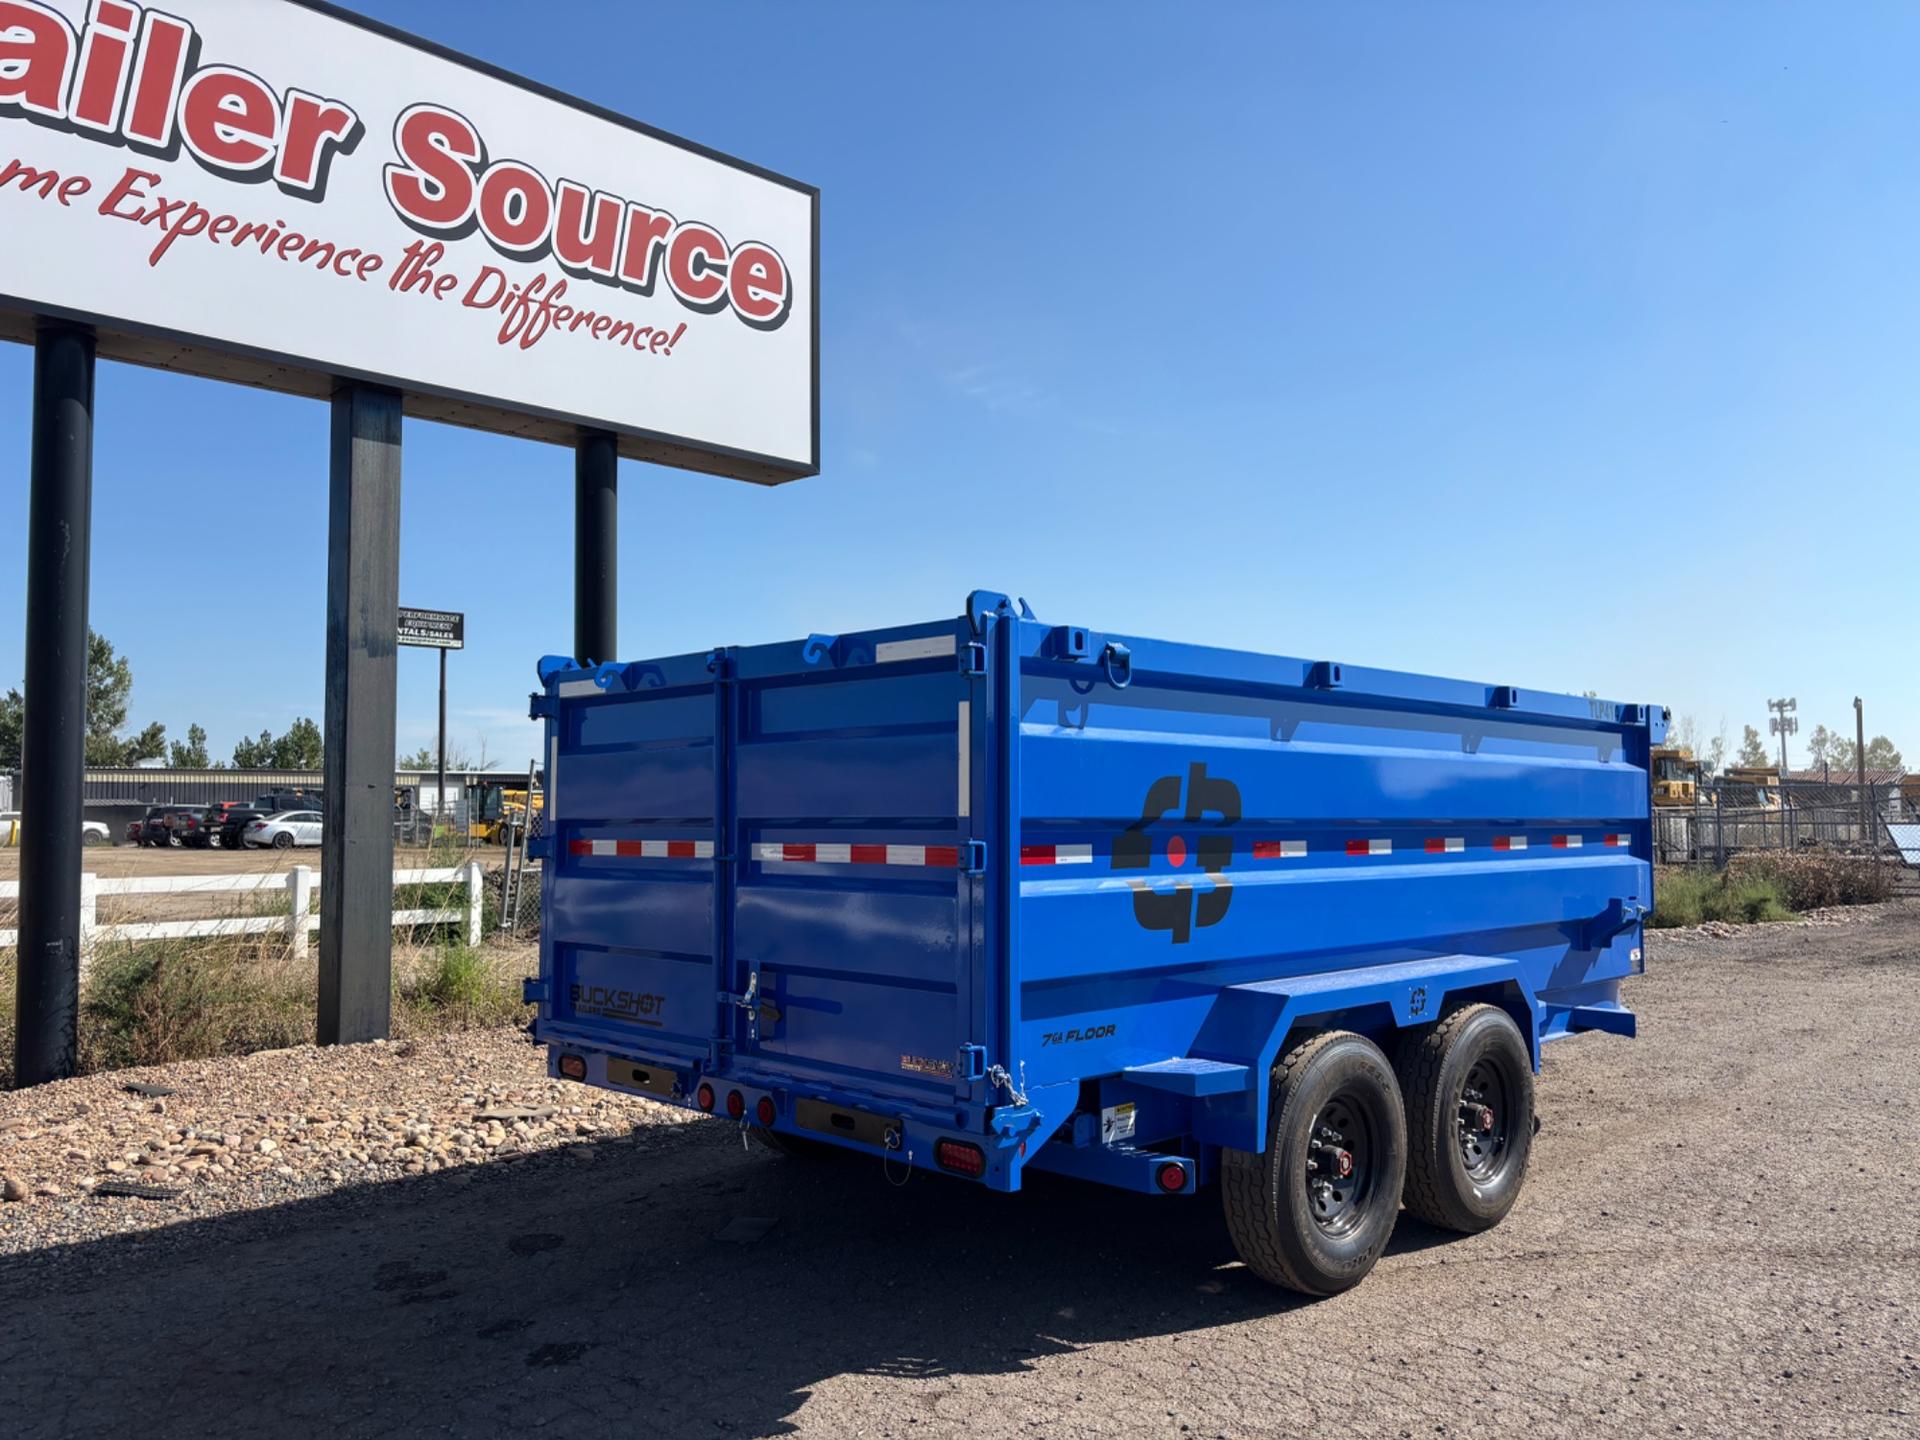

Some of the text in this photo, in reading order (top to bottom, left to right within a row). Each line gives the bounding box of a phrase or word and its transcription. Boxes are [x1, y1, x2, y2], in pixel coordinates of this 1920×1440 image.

[98, 167, 383, 281] Experience
[389, 240, 457, 300] the
[462, 265, 687, 356] Difference!
[382, 103, 793, 332] Source
[569, 983, 665, 1015] BUCKSHOT
[1064, 1024, 1116, 1044] FLOOR
